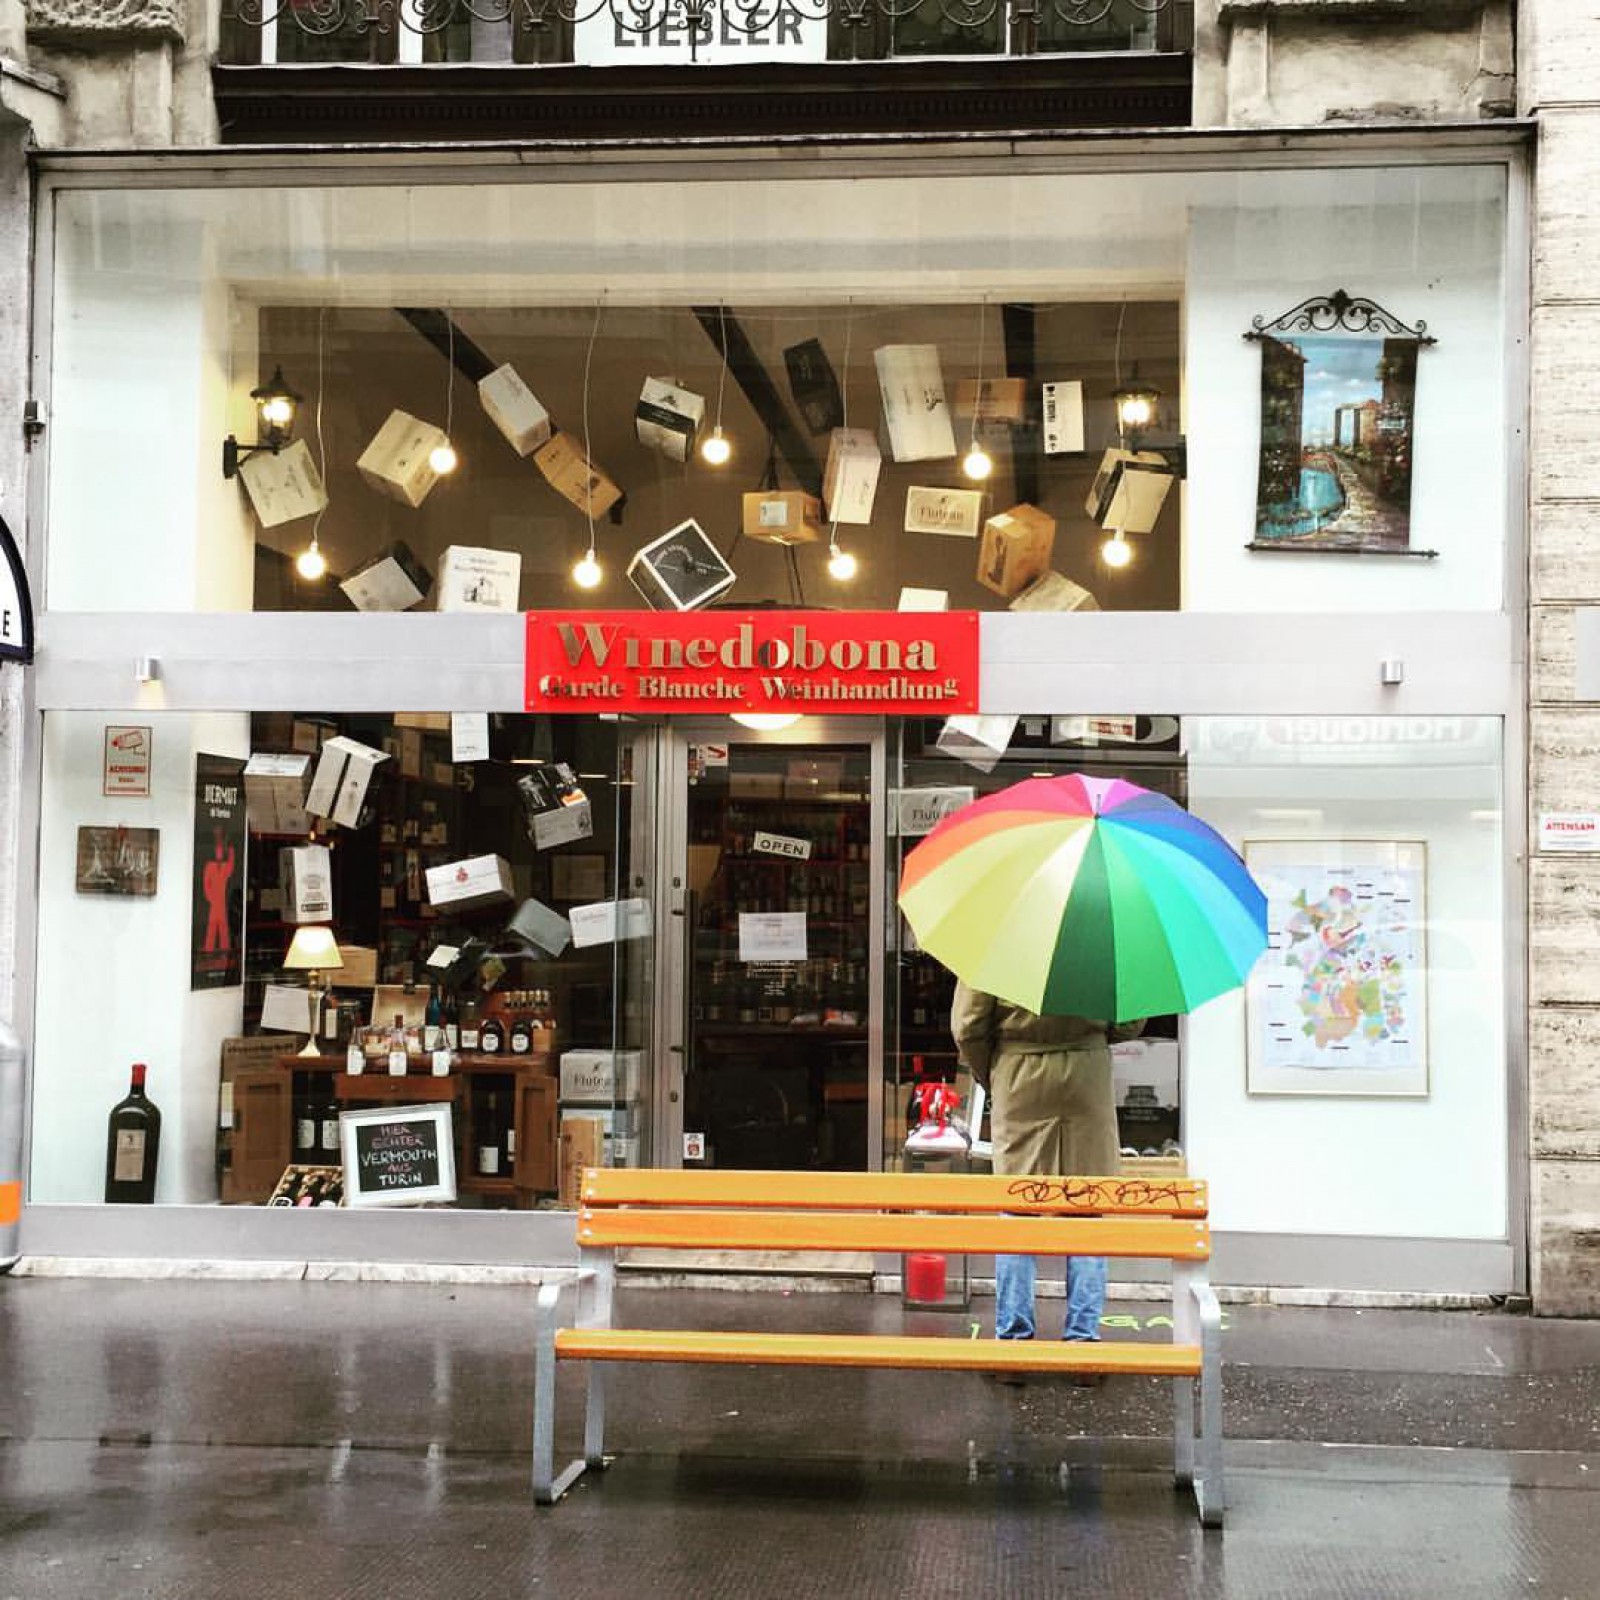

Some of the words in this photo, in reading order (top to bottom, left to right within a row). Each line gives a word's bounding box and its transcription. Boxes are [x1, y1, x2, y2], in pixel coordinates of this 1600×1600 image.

[614, 8, 804, 47] LIEBLER
[557, 622, 937, 672] Winedobona
[539, 674, 625, 699] Garde
[639, 674, 746, 699] Blanche
[760, 675, 960, 699] Weinhandlung
[1545, 821, 1595, 831] ATTENSAM
[759, 838, 806, 856] OPEN
[360, 1149, 437, 1167] VERMOUTH
[379, 1172, 423, 1186] TURIN
